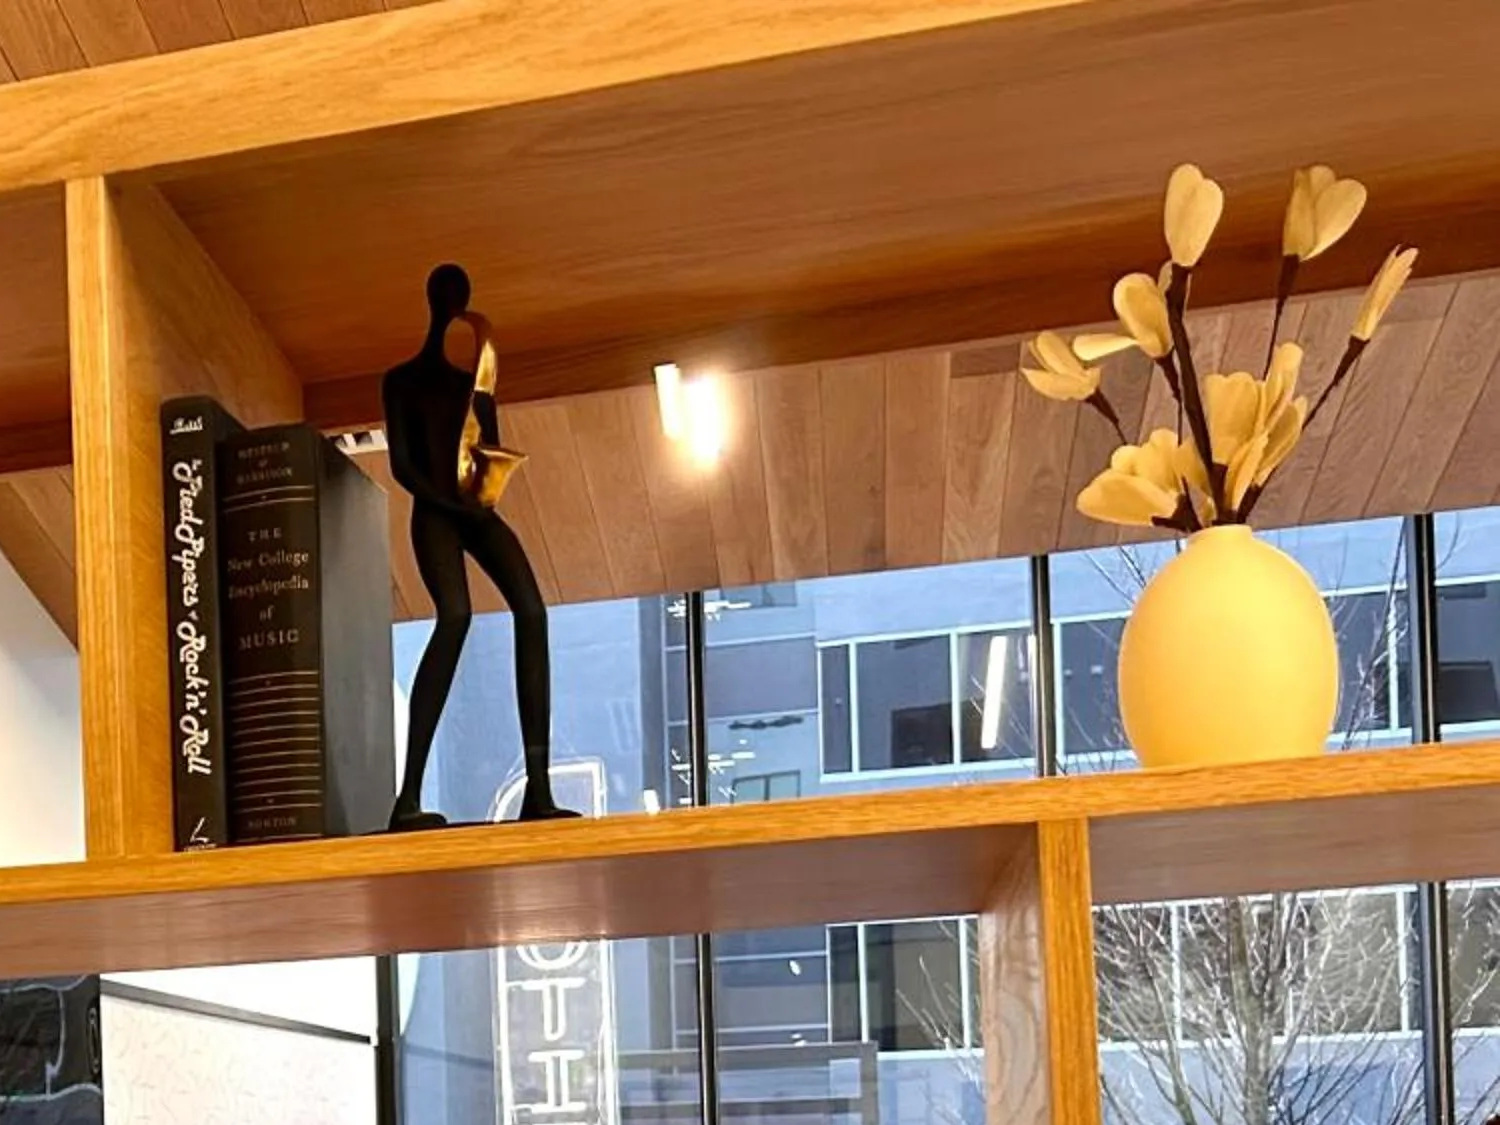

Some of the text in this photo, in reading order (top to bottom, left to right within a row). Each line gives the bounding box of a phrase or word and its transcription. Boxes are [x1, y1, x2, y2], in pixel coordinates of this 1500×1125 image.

[248, 527, 281, 542] THE
[259, 549, 309, 567] College
[239, 629, 299, 650] MUSIC
